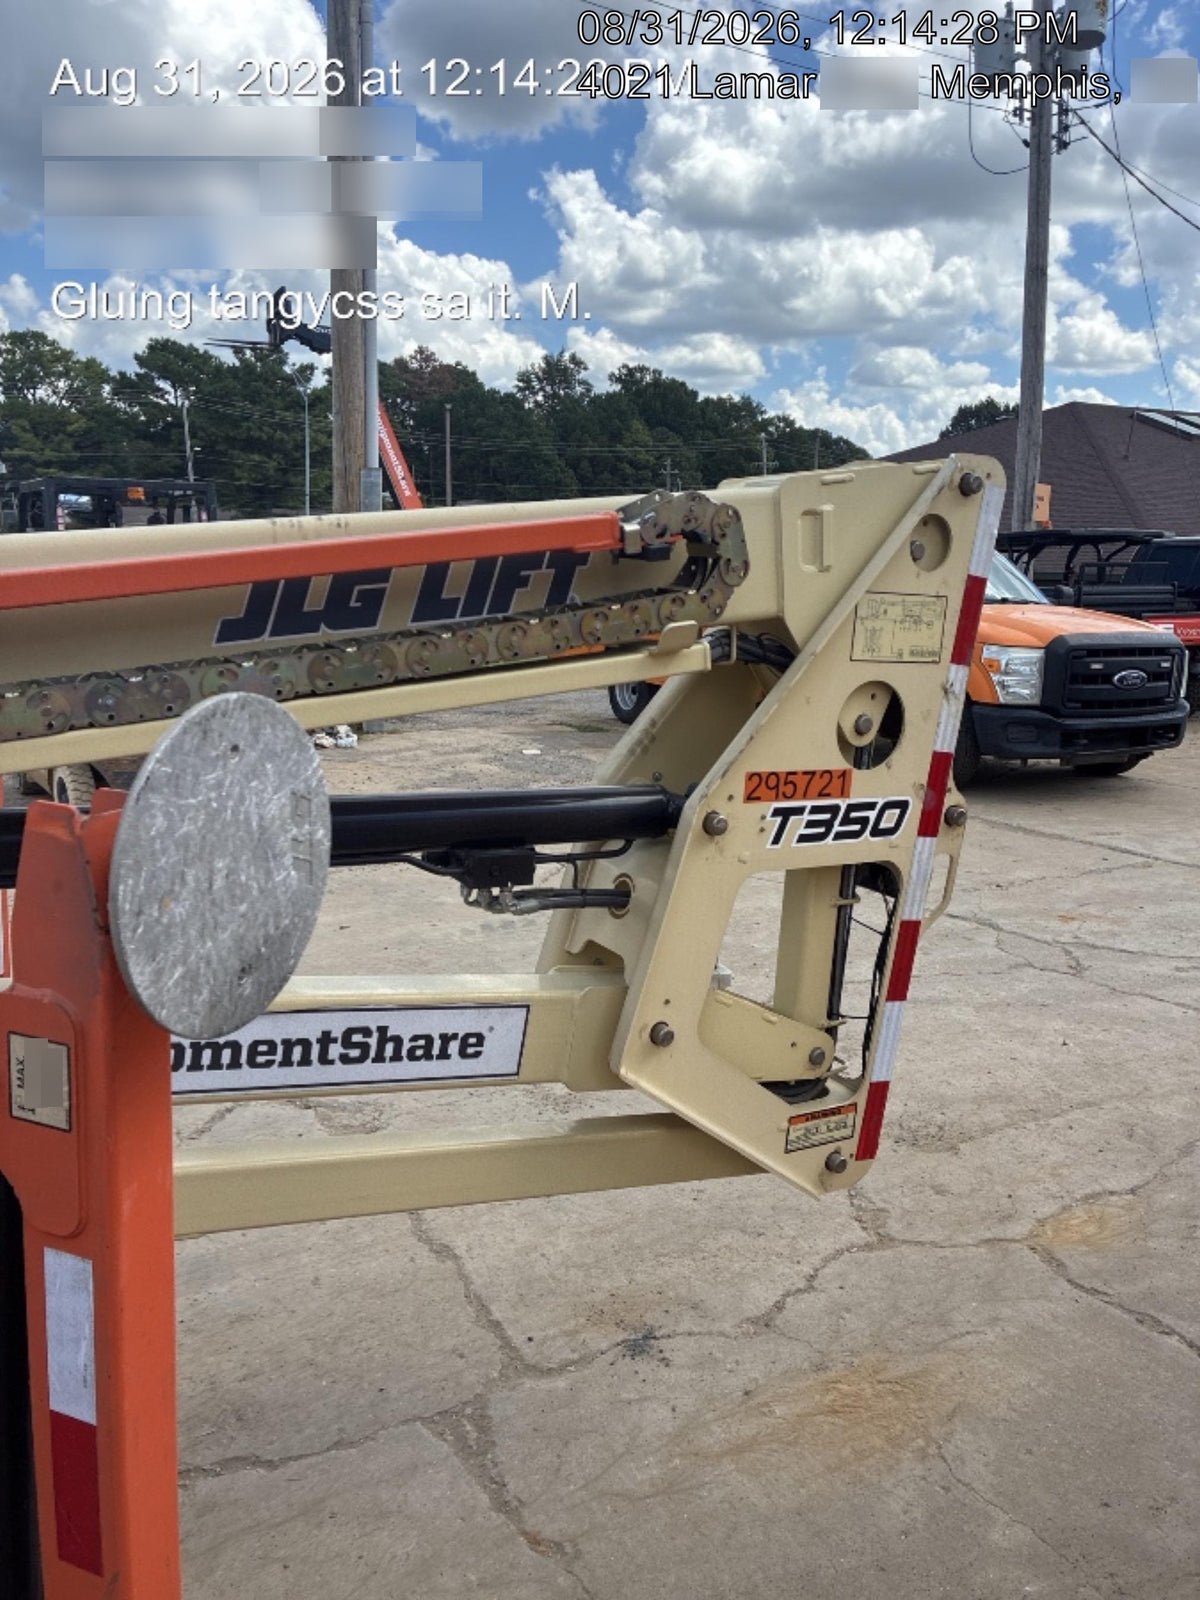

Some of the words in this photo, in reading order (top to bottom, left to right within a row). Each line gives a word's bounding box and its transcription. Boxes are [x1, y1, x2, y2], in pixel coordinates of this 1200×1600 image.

[212, 566, 396, 647] JLG
[409, 550, 592, 626] LIFT
[746, 769, 847, 801] 295721
[768, 799, 911, 847] T350
